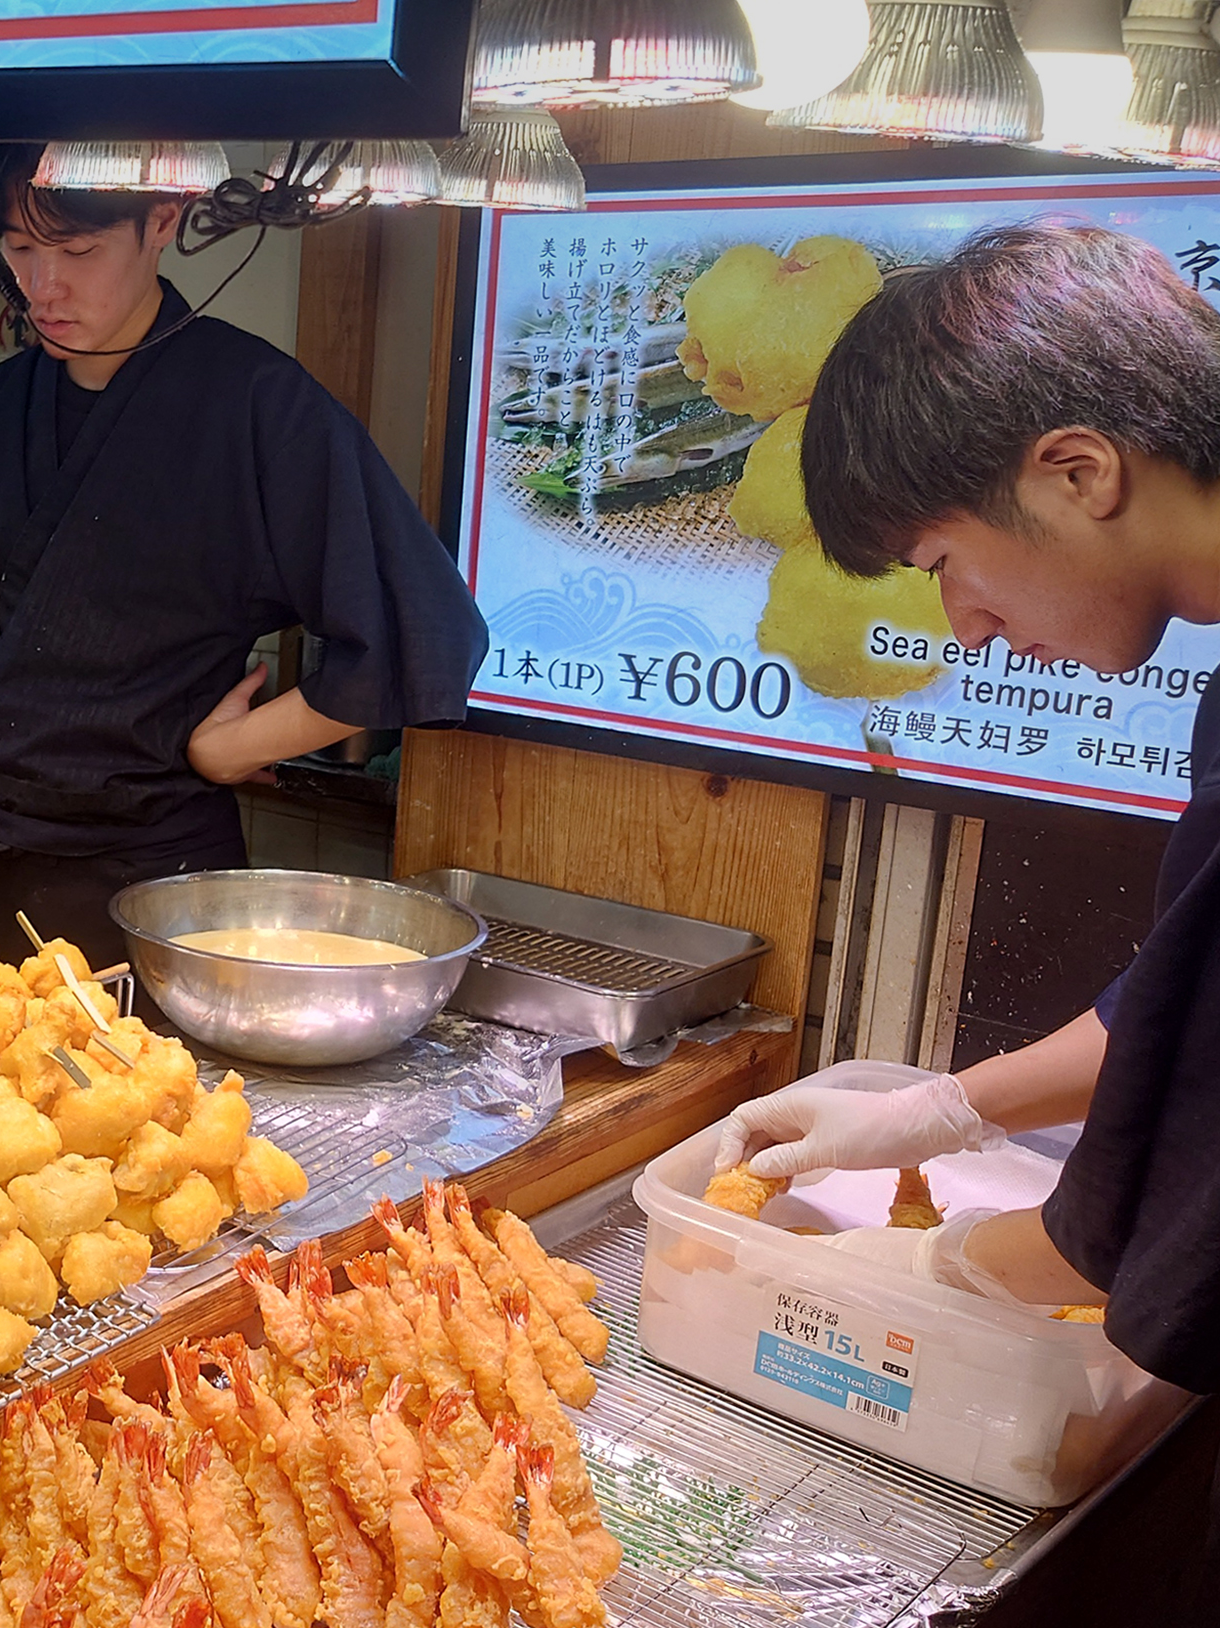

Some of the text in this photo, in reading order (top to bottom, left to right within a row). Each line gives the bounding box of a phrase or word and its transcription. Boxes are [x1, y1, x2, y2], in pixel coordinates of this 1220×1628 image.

[532, 237, 558, 418] 美味しい一品です。
[612, 236, 650, 474] サクッと食感に口の中で
[579, 237, 618, 528] ホロリとほどけるはも天ぷら。
[869, 625, 930, 663] Sea
[493, 648, 792, 721] 1本(1P) ¥600
[960, 674, 1115, 721] tempura
[868, 704, 1050, 757] 海鳗天妇罗
[776, 1292, 840, 1327] 保存容器
[773, 1311, 866, 1363] 浅型 15L
